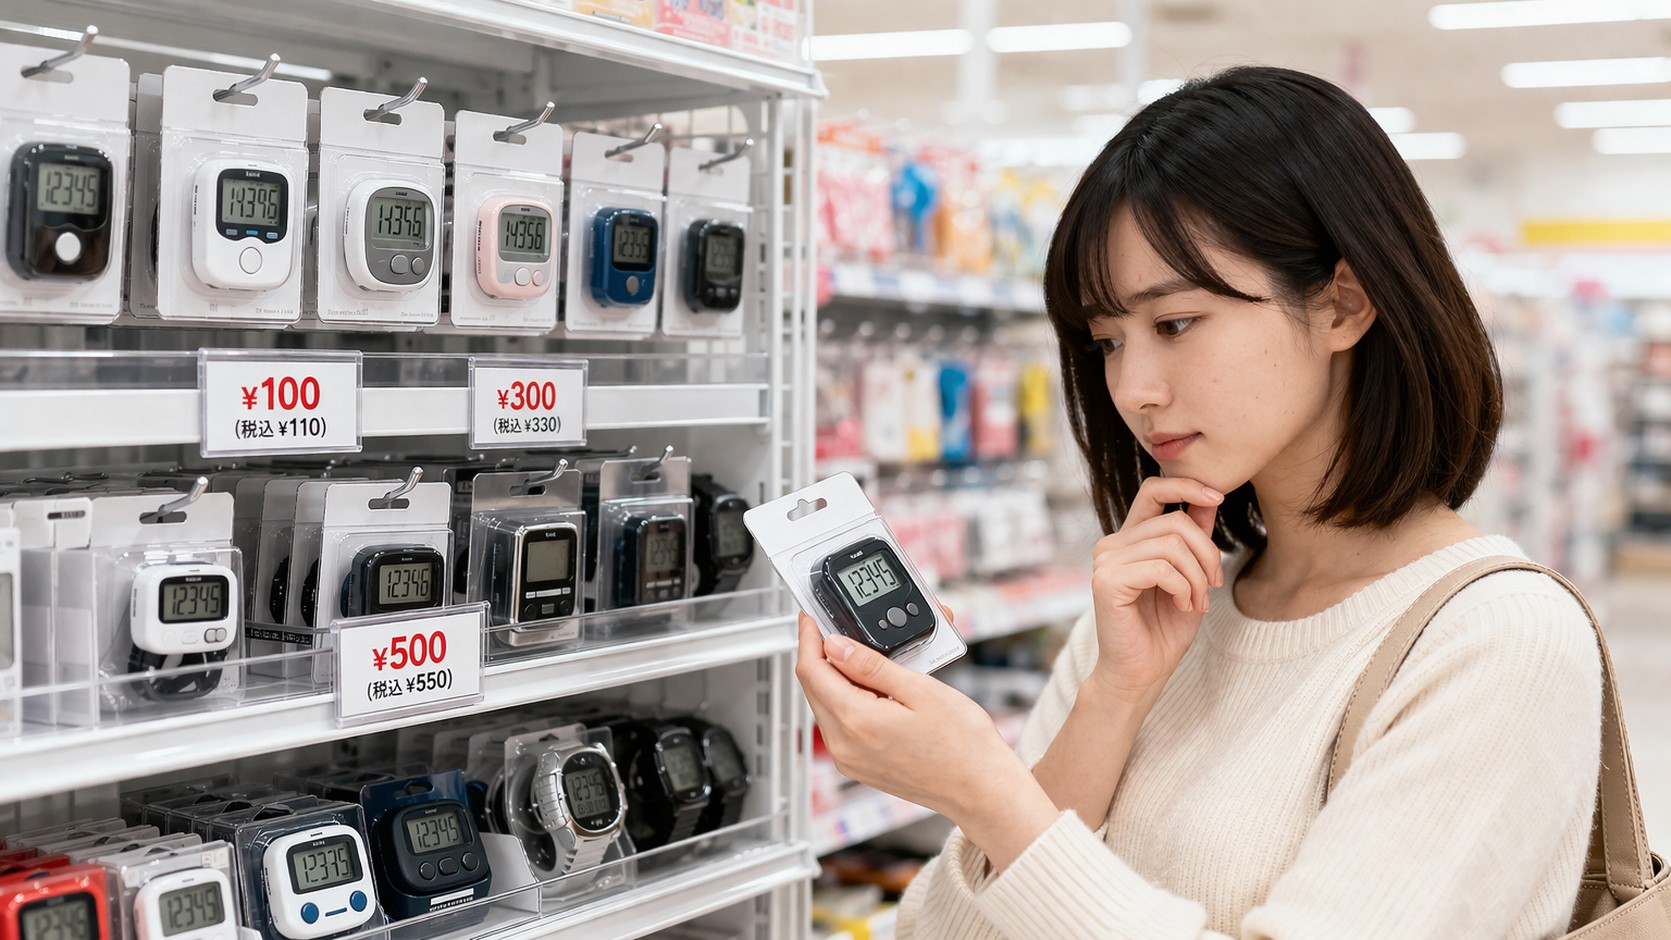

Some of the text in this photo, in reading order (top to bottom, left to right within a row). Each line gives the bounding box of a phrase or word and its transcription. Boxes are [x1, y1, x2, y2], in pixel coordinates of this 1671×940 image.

[45, 171, 97, 208] 12345
[505, 220, 543, 250] 14356
[241, 376, 320, 411] ¥100
[497, 381, 556, 411] ¥300
[235, 417, 327, 439] (税込 ¥110)
[493, 416, 561, 434] (税込 ¥330)
[847, 558, 897, 600] 12345
[172, 585, 219, 616] 12345
[372, 630, 447, 671] ¥500
[367, 668, 453, 701] (税込 ¥550)
[415, 816, 459, 849] 12345
[166, 884, 218, 929] 12345
